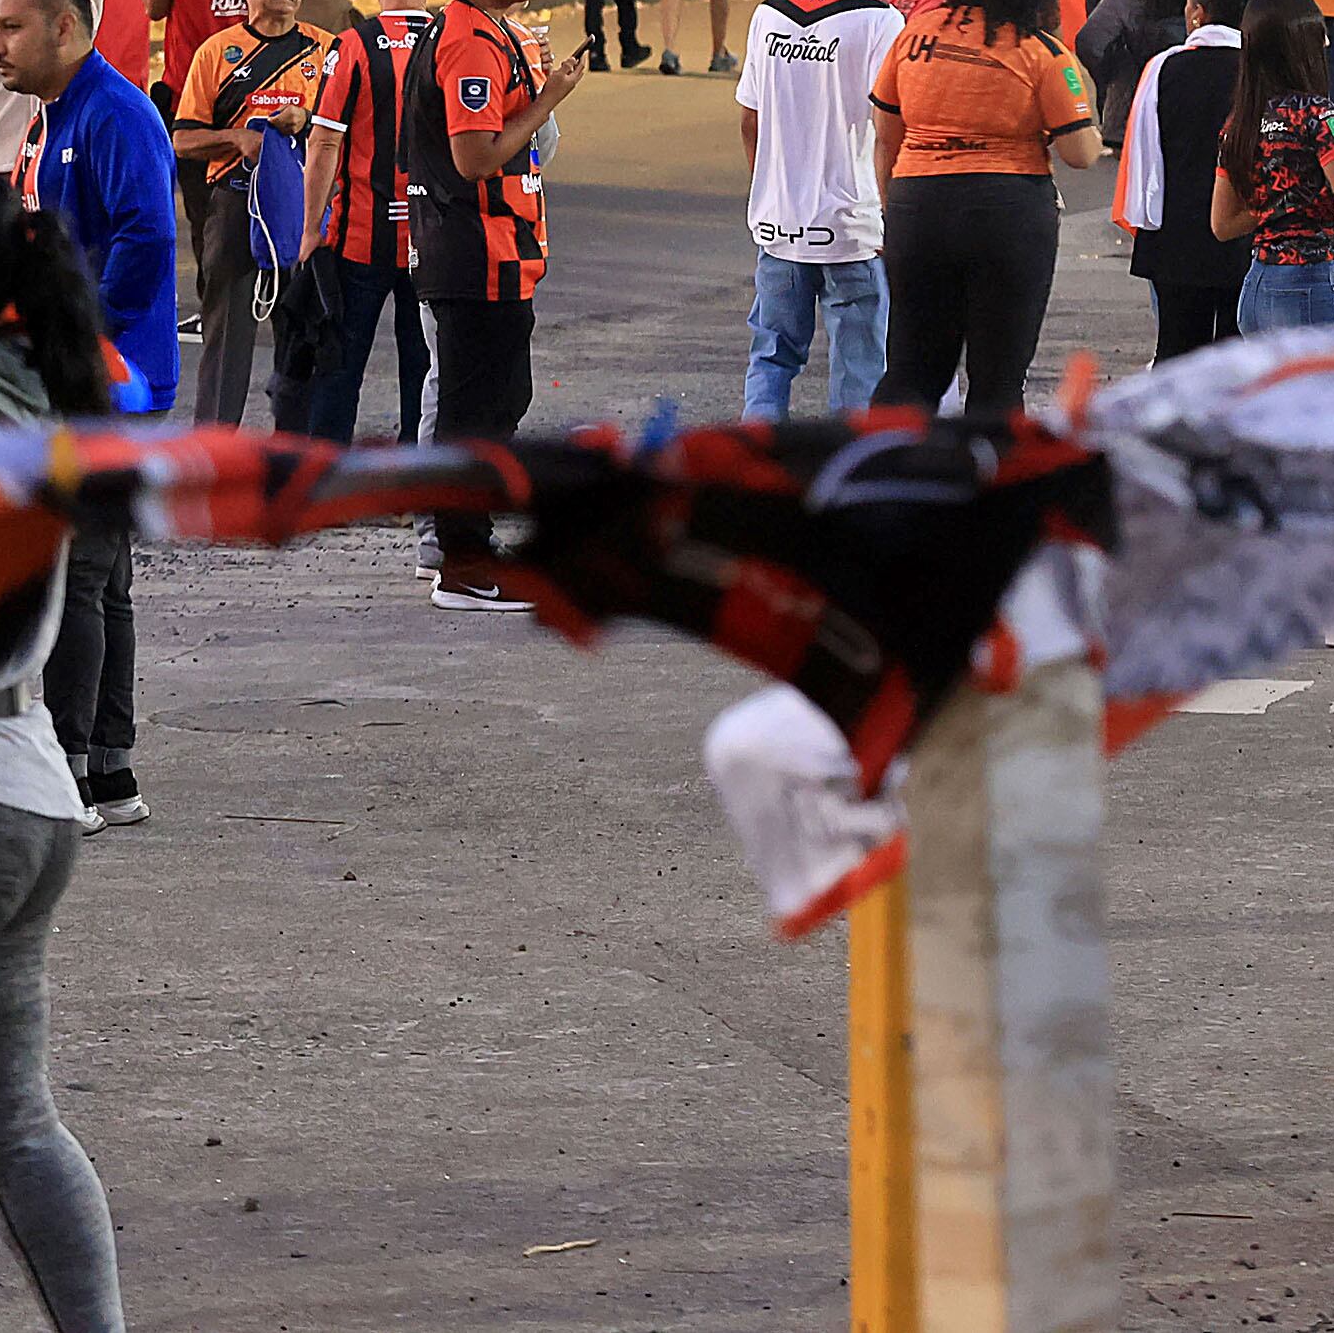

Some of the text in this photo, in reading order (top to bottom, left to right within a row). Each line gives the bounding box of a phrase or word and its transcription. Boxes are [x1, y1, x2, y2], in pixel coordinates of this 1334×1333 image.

[765, 32, 840, 63] Tropical
[907, 34, 939, 63] UH
[251, 94, 301, 106] Sabanero
[758, 222, 835, 246] BYD
